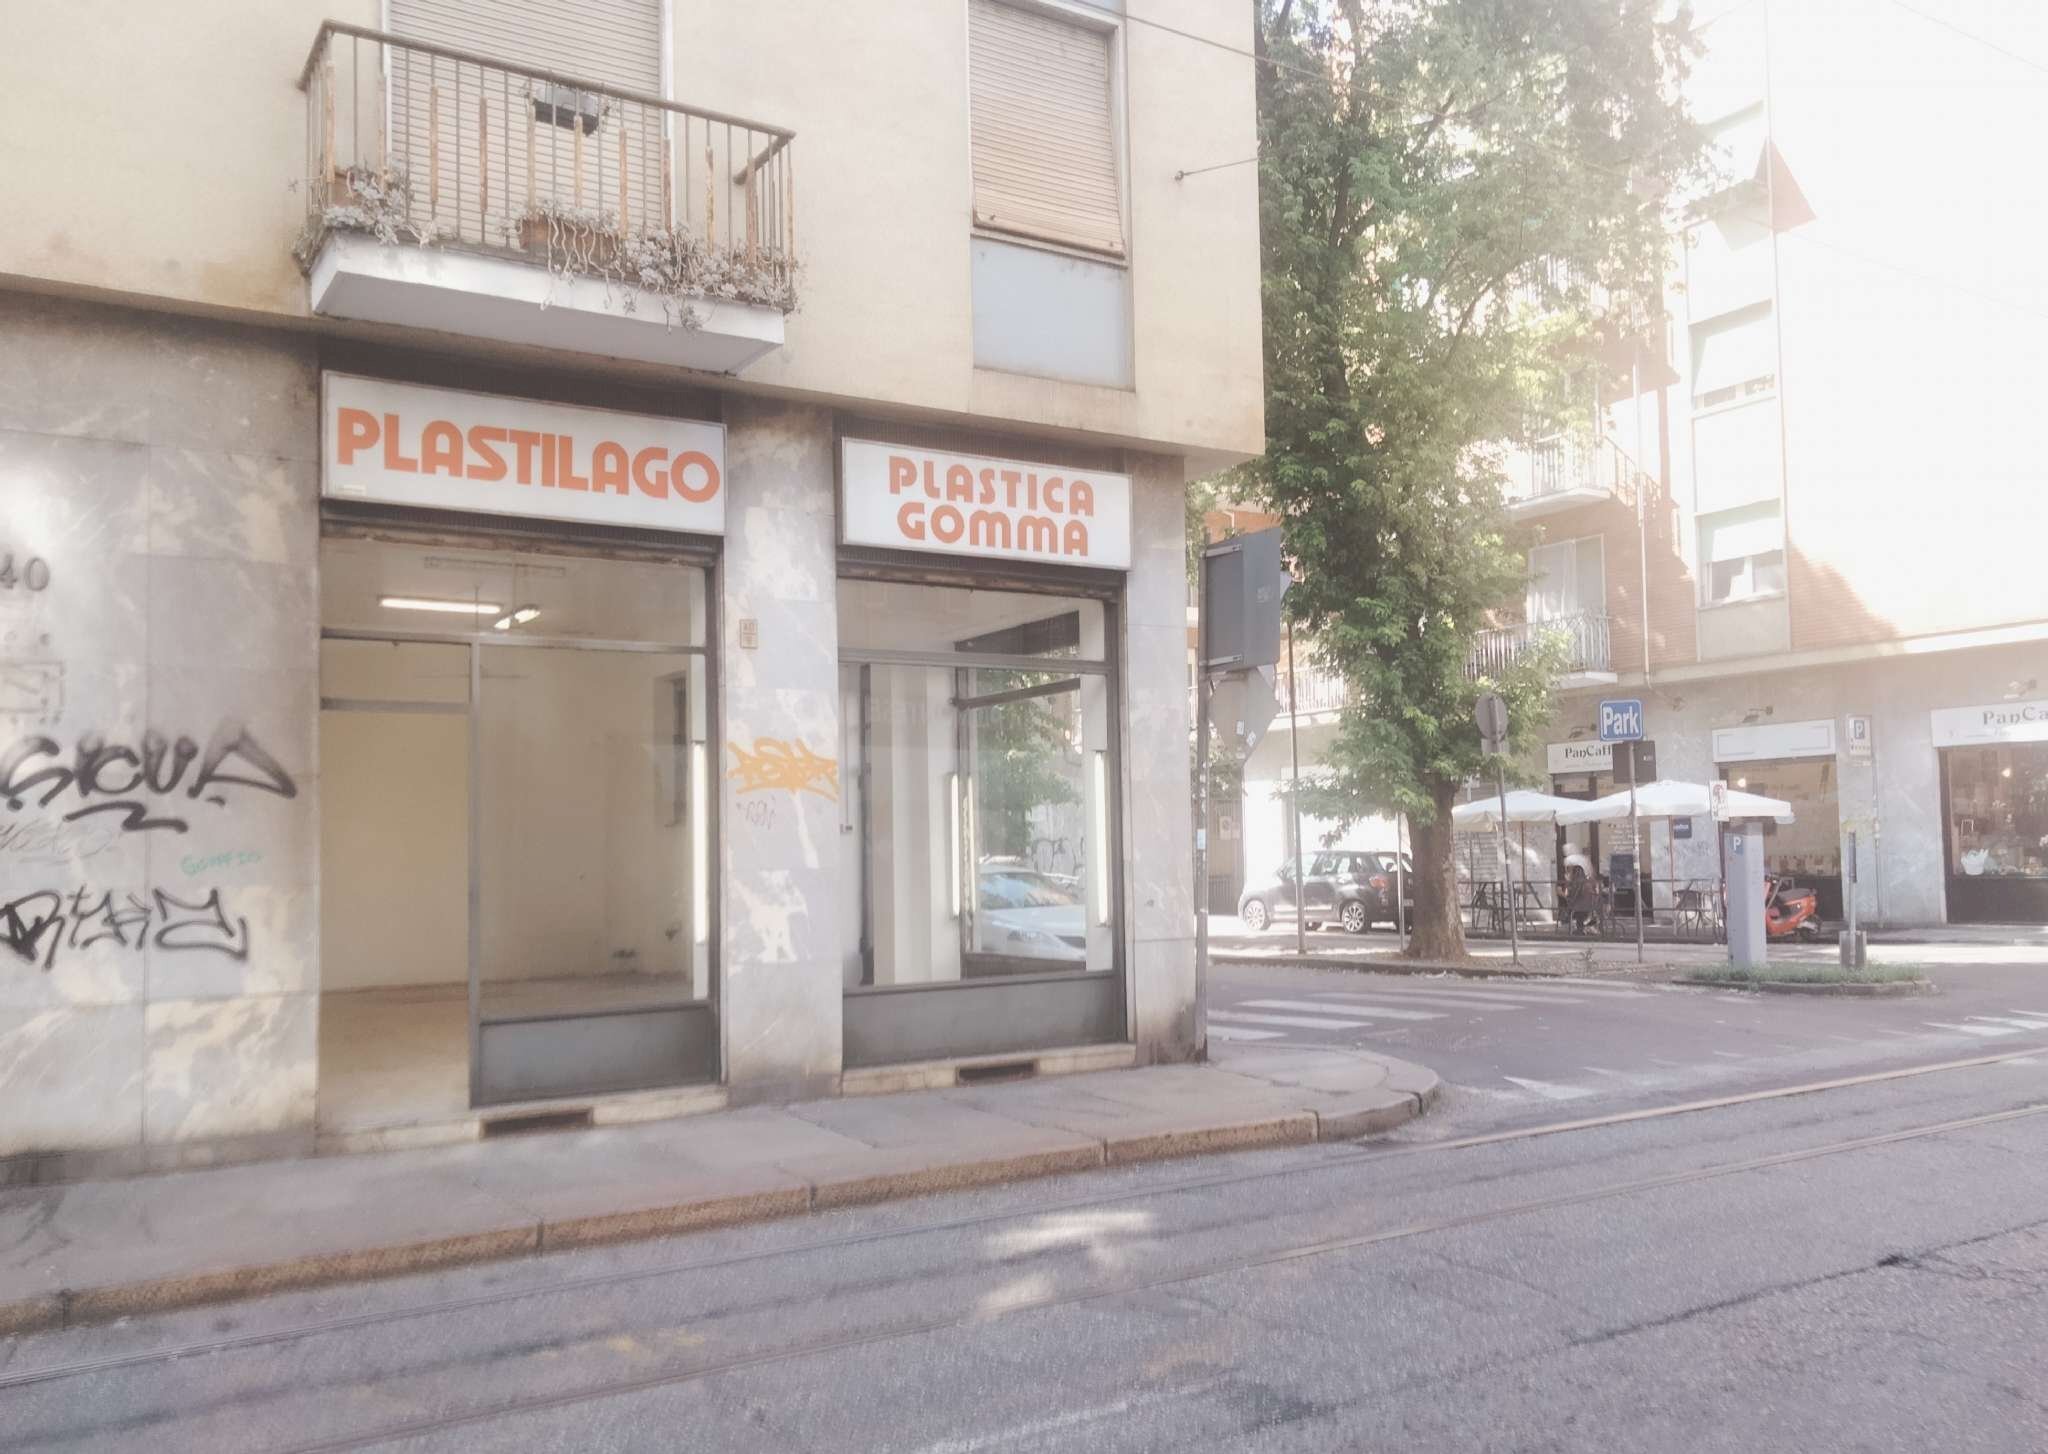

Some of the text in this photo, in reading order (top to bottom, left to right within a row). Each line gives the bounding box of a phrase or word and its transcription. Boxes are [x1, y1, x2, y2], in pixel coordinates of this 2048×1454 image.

[337, 406, 721, 504] PLASTILAGO
[888, 455, 1094, 517] PLASTICA
[897, 501, 1089, 557] GOMMA
[1602, 704, 1639, 736] Park
[1983, 706, 2048, 726] PanCa
[1565, 744, 1612, 759] PanCaff
[1733, 836, 1742, 851] P
